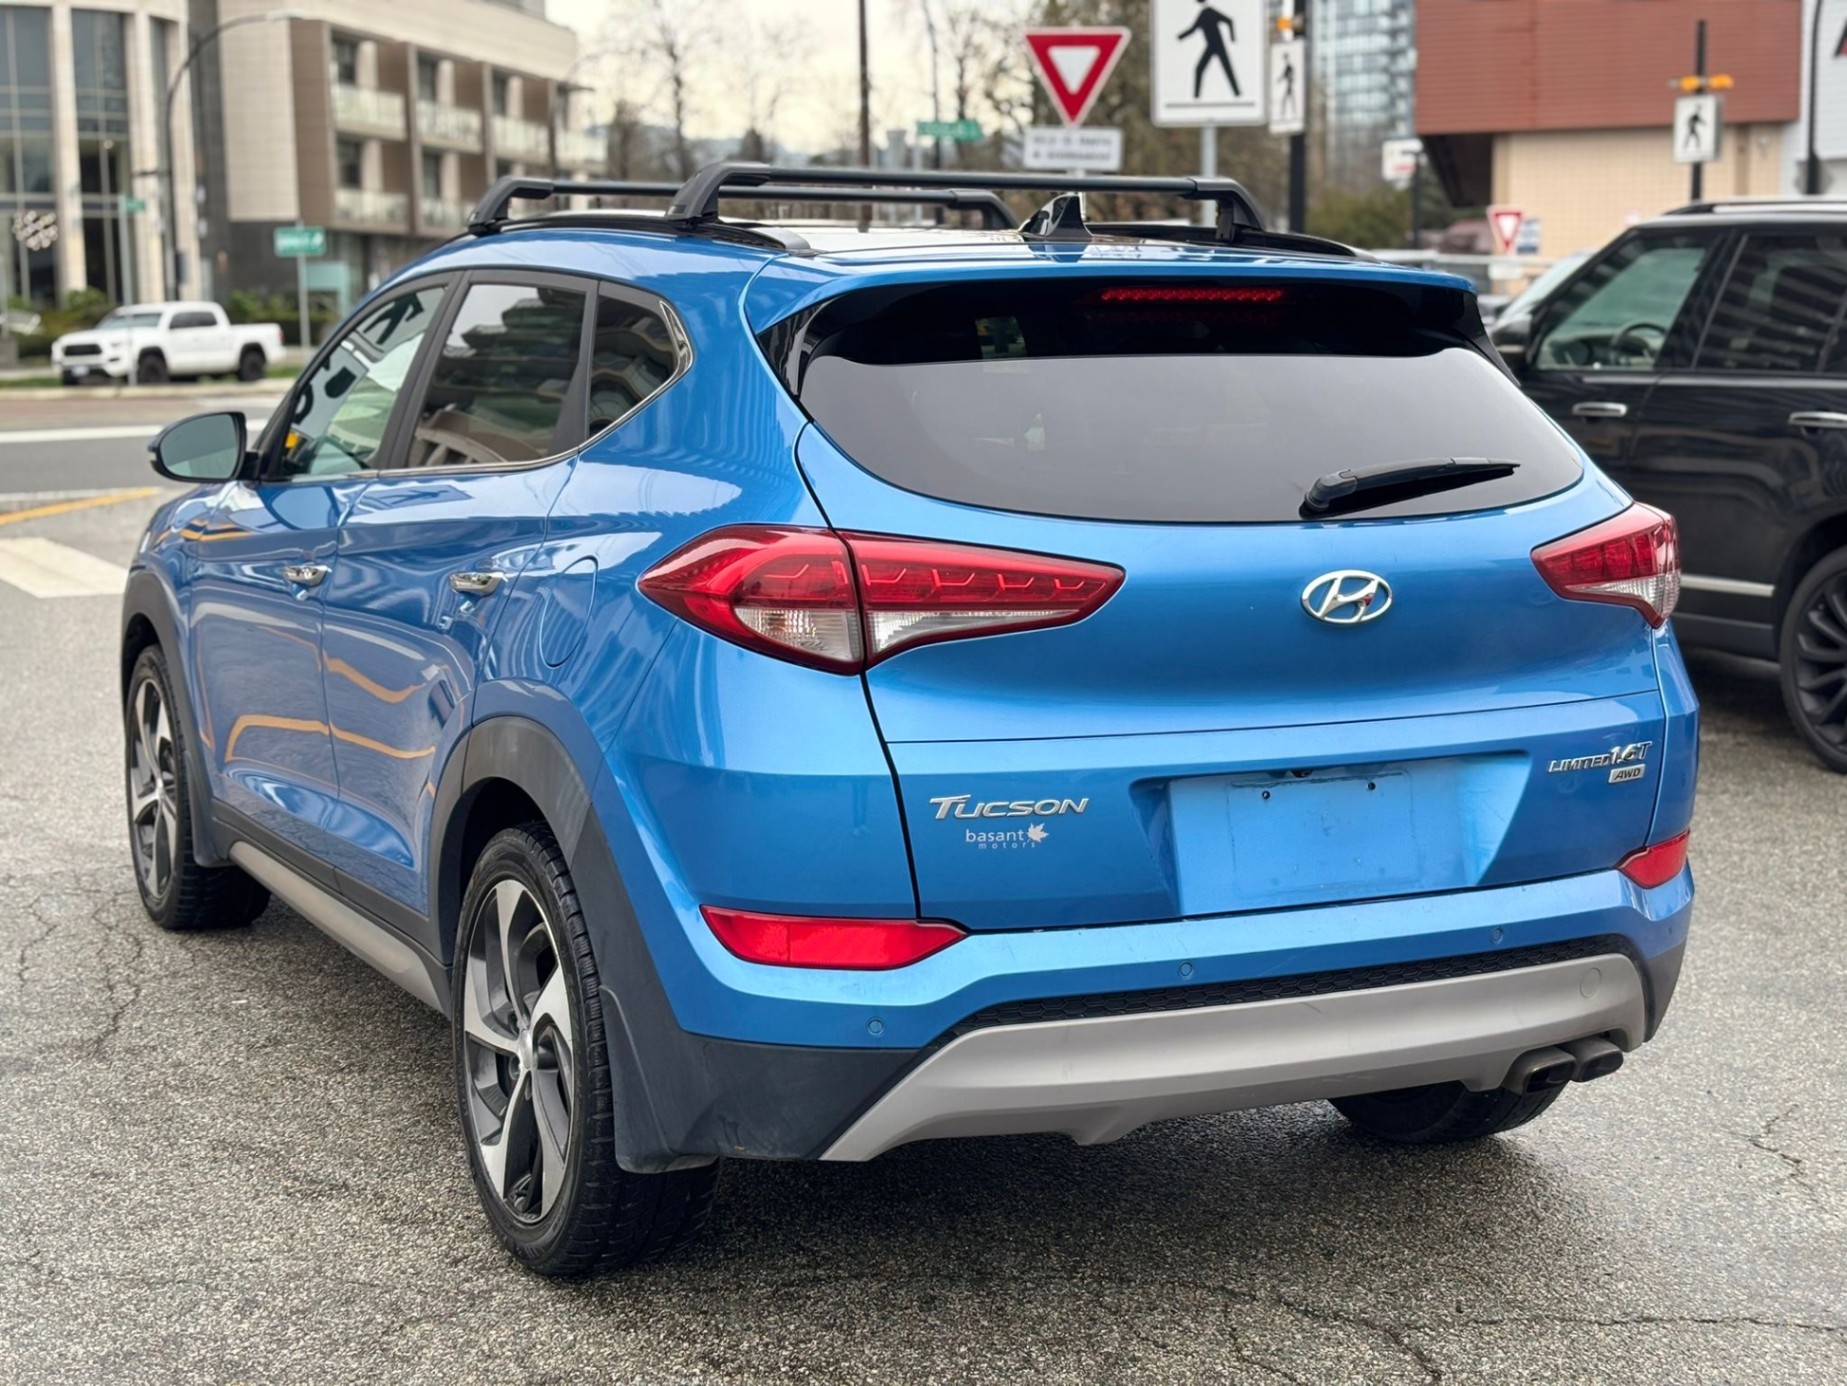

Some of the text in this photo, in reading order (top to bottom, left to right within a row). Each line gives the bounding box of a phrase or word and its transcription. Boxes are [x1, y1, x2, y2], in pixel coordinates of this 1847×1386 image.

[1614, 767, 1642, 781] AWD
[929, 794, 1089, 820] TUCSON
[965, 828, 1024, 843] basant
[978, 841, 1036, 850] motors
